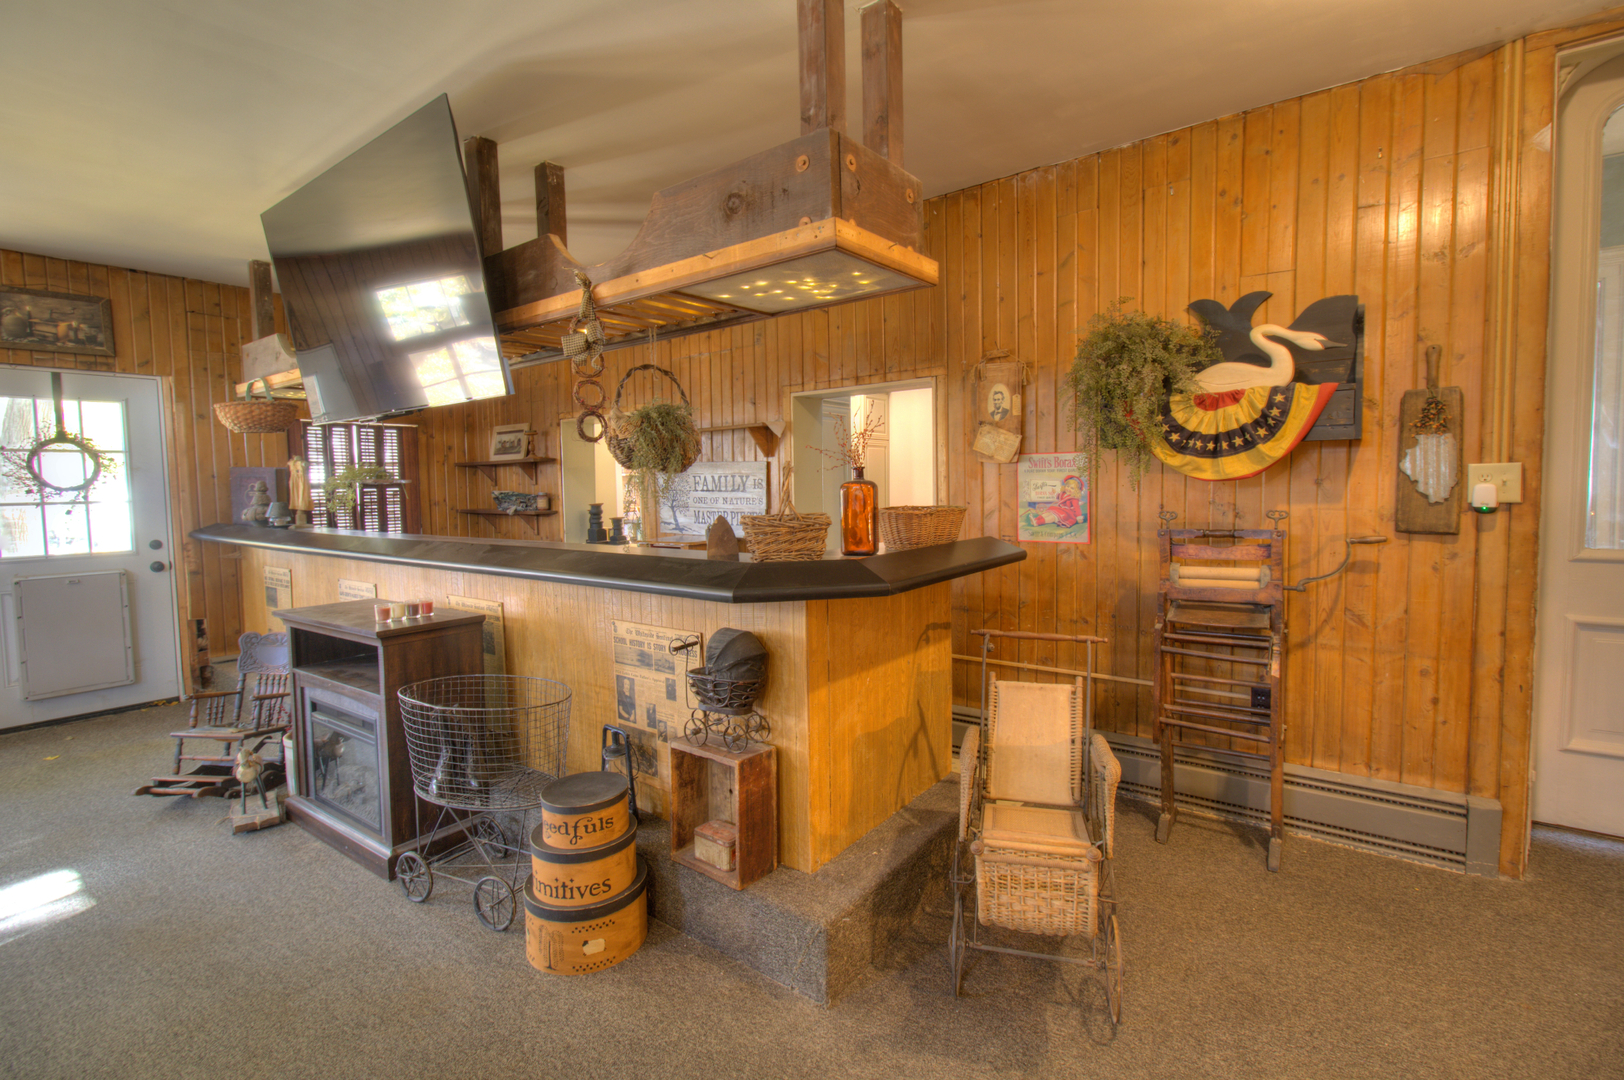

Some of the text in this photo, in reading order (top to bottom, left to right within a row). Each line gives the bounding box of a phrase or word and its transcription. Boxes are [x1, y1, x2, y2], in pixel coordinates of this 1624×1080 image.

[692, 475, 764, 492] FAMILY IS
[710, 497, 720, 505] OF
[722, 497, 764, 506] NATURE'S
[629, 639, 645, 648] HISTORY
[653, 643, 666, 652] STORY
[543, 816, 614, 846] eedfuls
[532, 870, 612, 900] imitives
